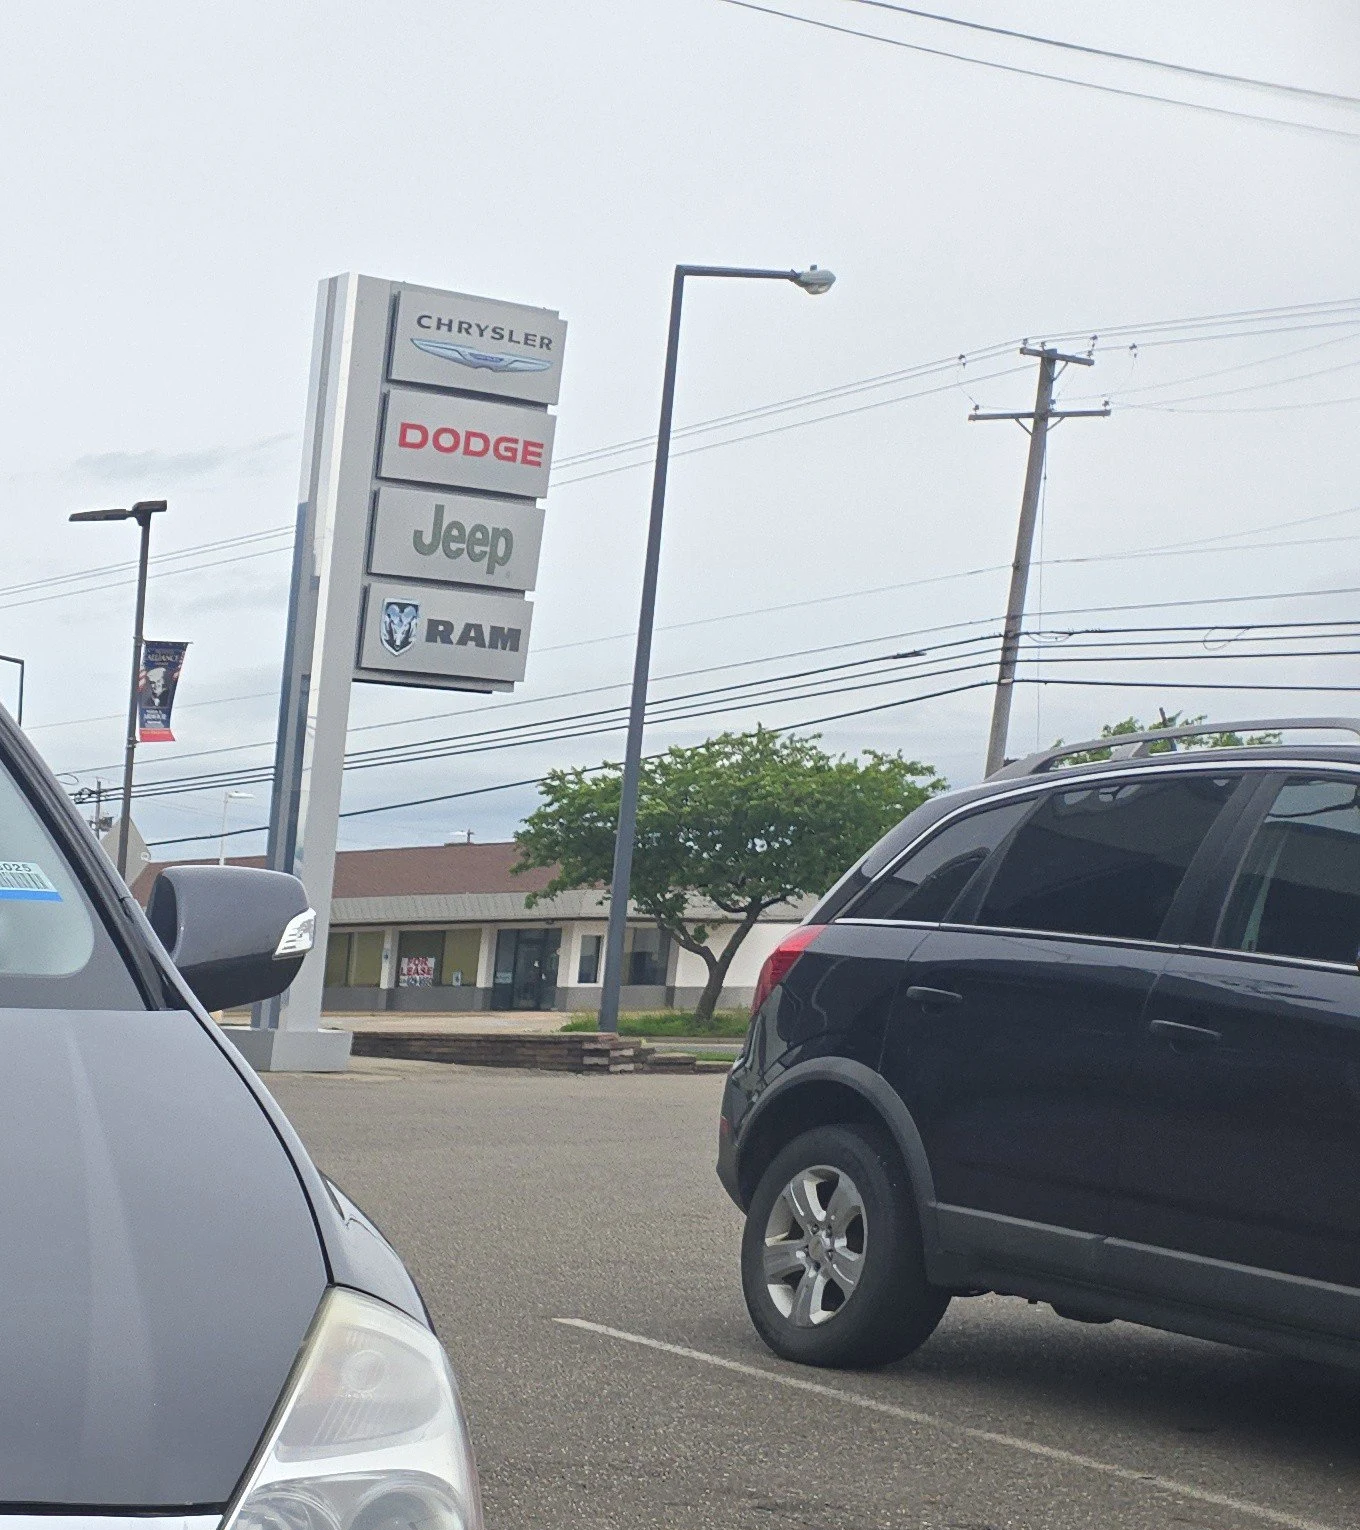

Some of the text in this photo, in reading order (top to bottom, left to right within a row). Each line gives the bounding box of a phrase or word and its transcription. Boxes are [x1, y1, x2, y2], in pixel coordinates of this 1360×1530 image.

[416, 314, 553, 351] CHRYSLER
[398, 422, 544, 468] DODGE
[412, 503, 514, 575] Jeep
[425, 618, 522, 653] RAM
